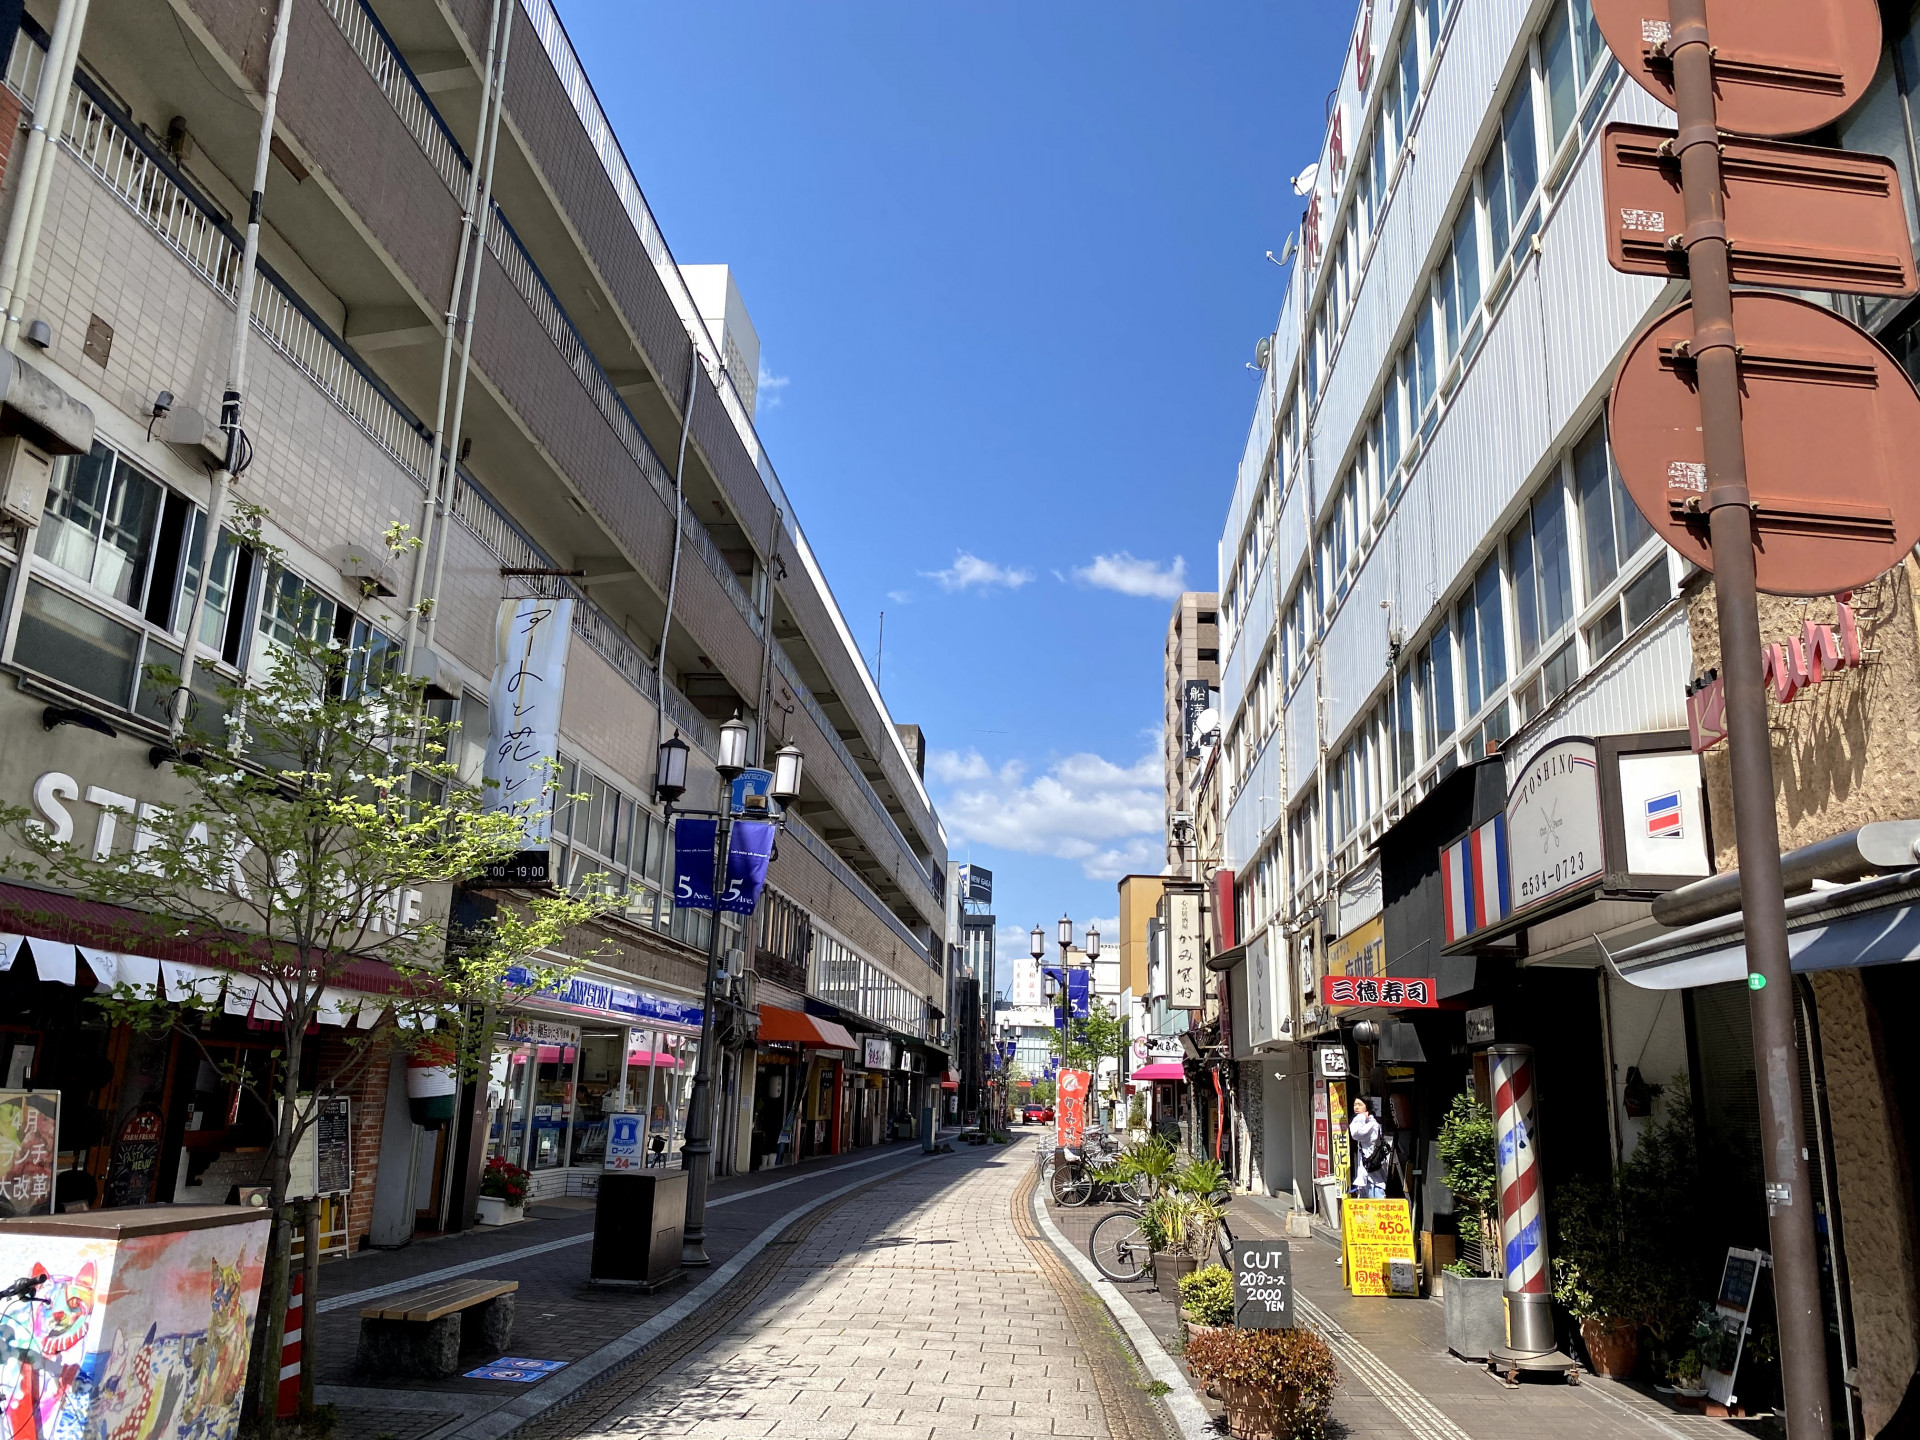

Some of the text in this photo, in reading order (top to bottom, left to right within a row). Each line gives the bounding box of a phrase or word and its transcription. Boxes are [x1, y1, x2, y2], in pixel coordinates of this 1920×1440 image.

[1523, 754, 1574, 804] TOSHINO
[25, 772, 255, 900] STEAK
[1529, 851, 1584, 894] 534-0723
[677, 875, 711, 900] 5 Ave.
[721, 879, 753, 904] 5 Ave.
[1331, 979, 1429, 1004] 三徳寿司
[1070, 999, 1079, 1013] 5
[11, 1109, 39, 1133] 4月
[1, 1143, 47, 1166] ランチ
[611, 1147, 635, 1155] ローソン
[614, 1157, 629, 1169] 24
[1243, 1251, 1282, 1269] CUT
[1240, 1271, 1286, 1287] 20分コース
[1246, 1288, 1281, 1300] 2000
[1264, 1300, 1284, 1312] YEN
